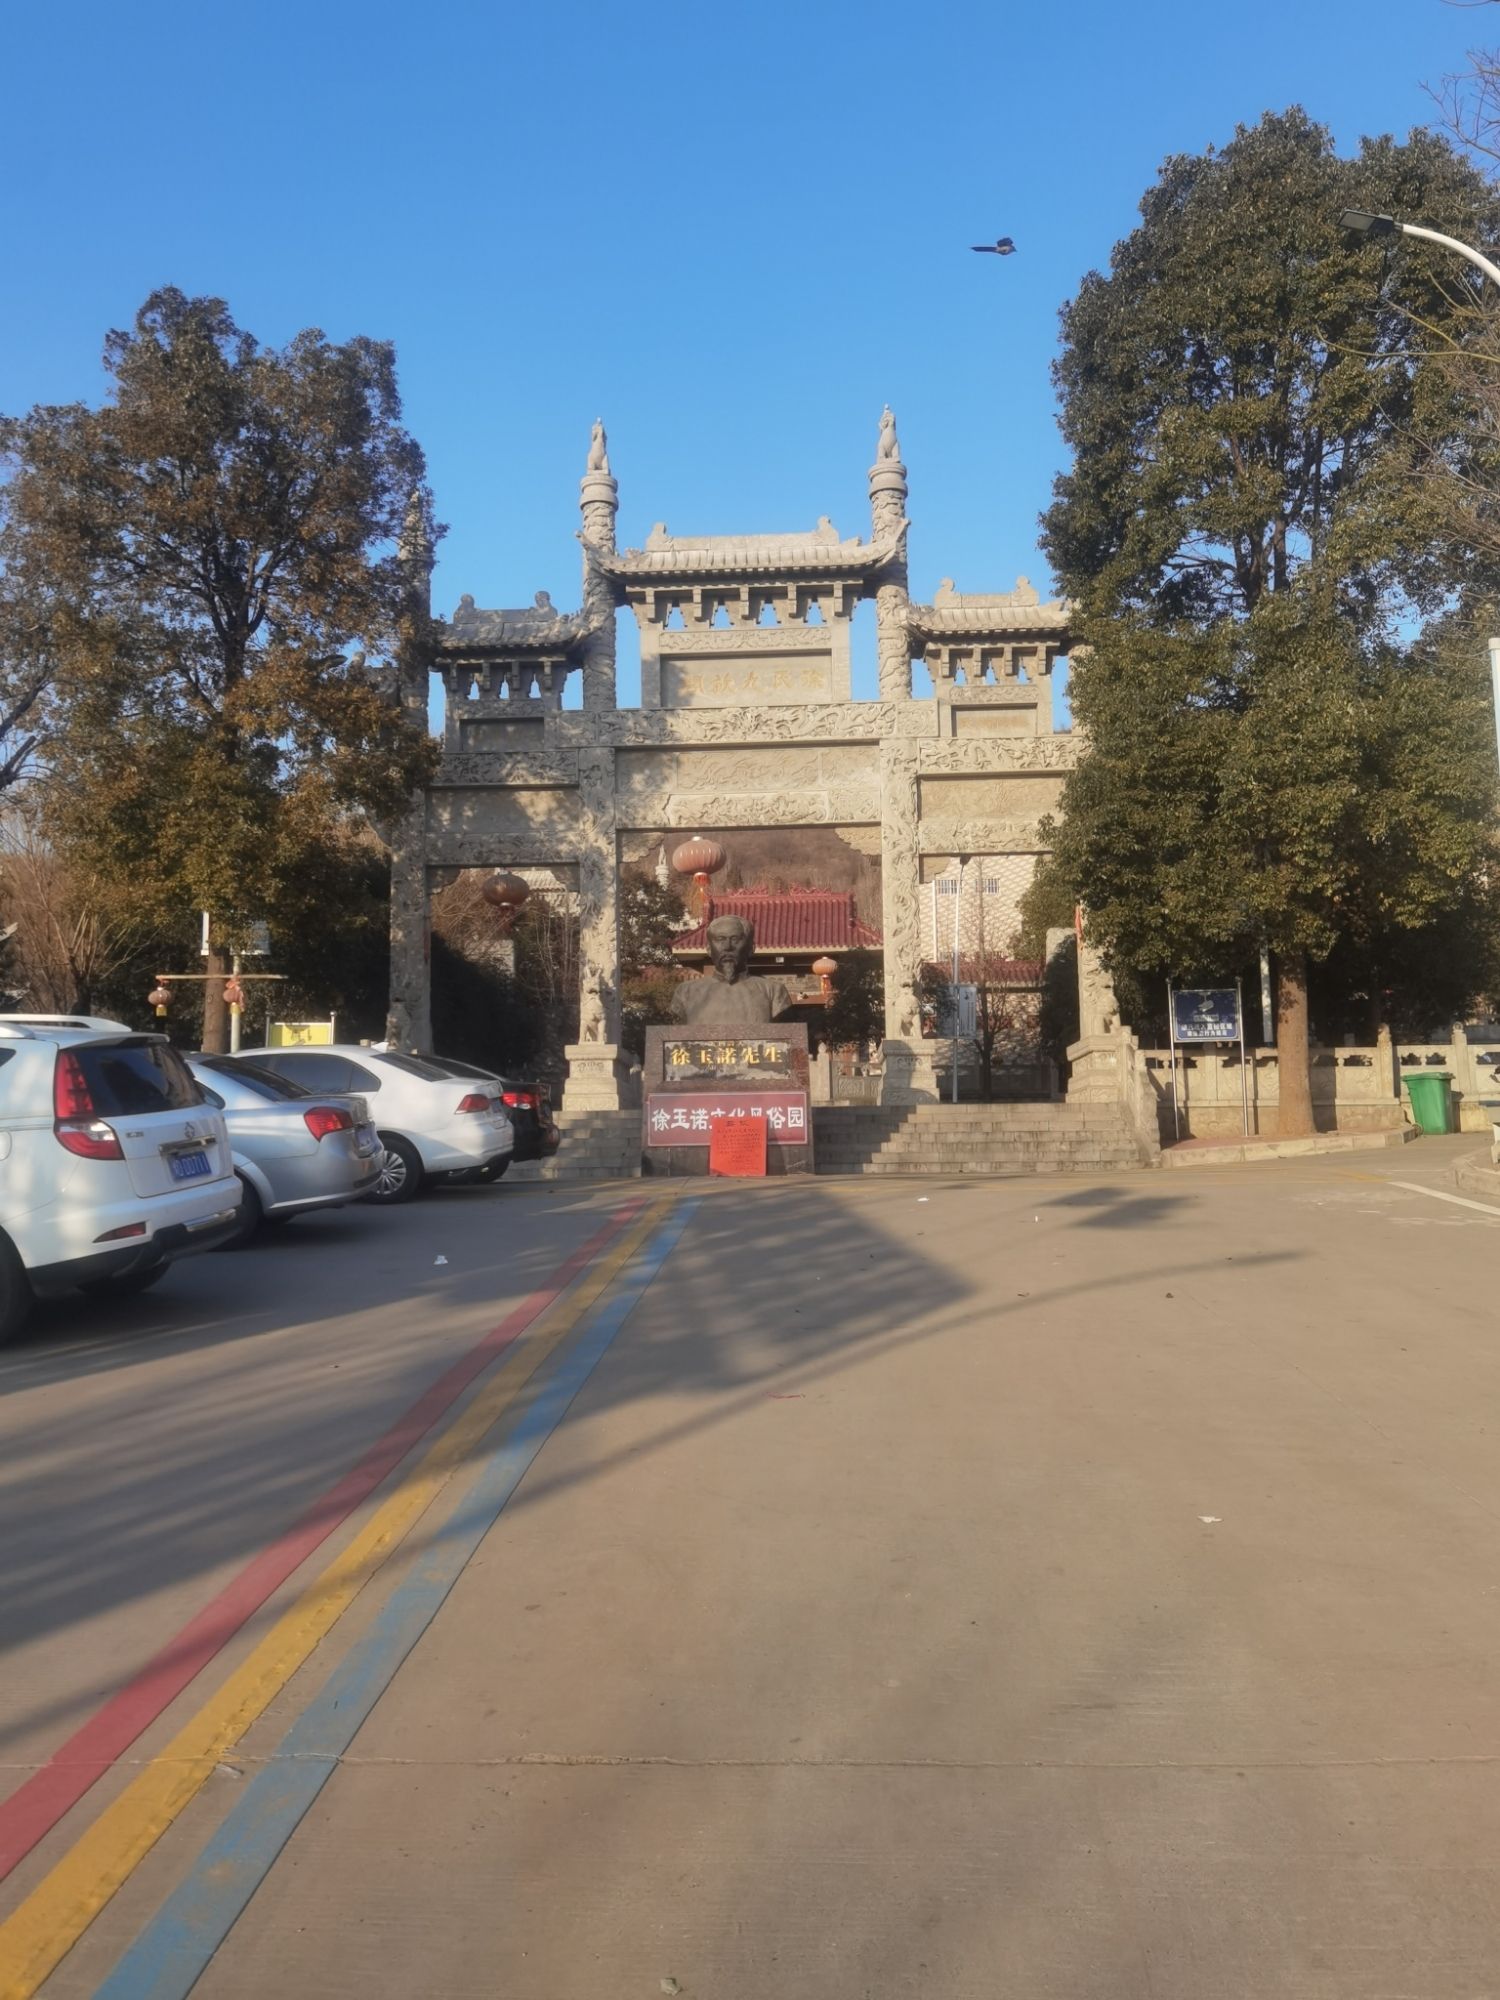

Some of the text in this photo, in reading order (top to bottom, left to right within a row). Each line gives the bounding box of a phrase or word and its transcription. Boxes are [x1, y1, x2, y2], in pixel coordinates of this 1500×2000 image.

[672, 1046, 783, 1066] 徐玉諾先生
